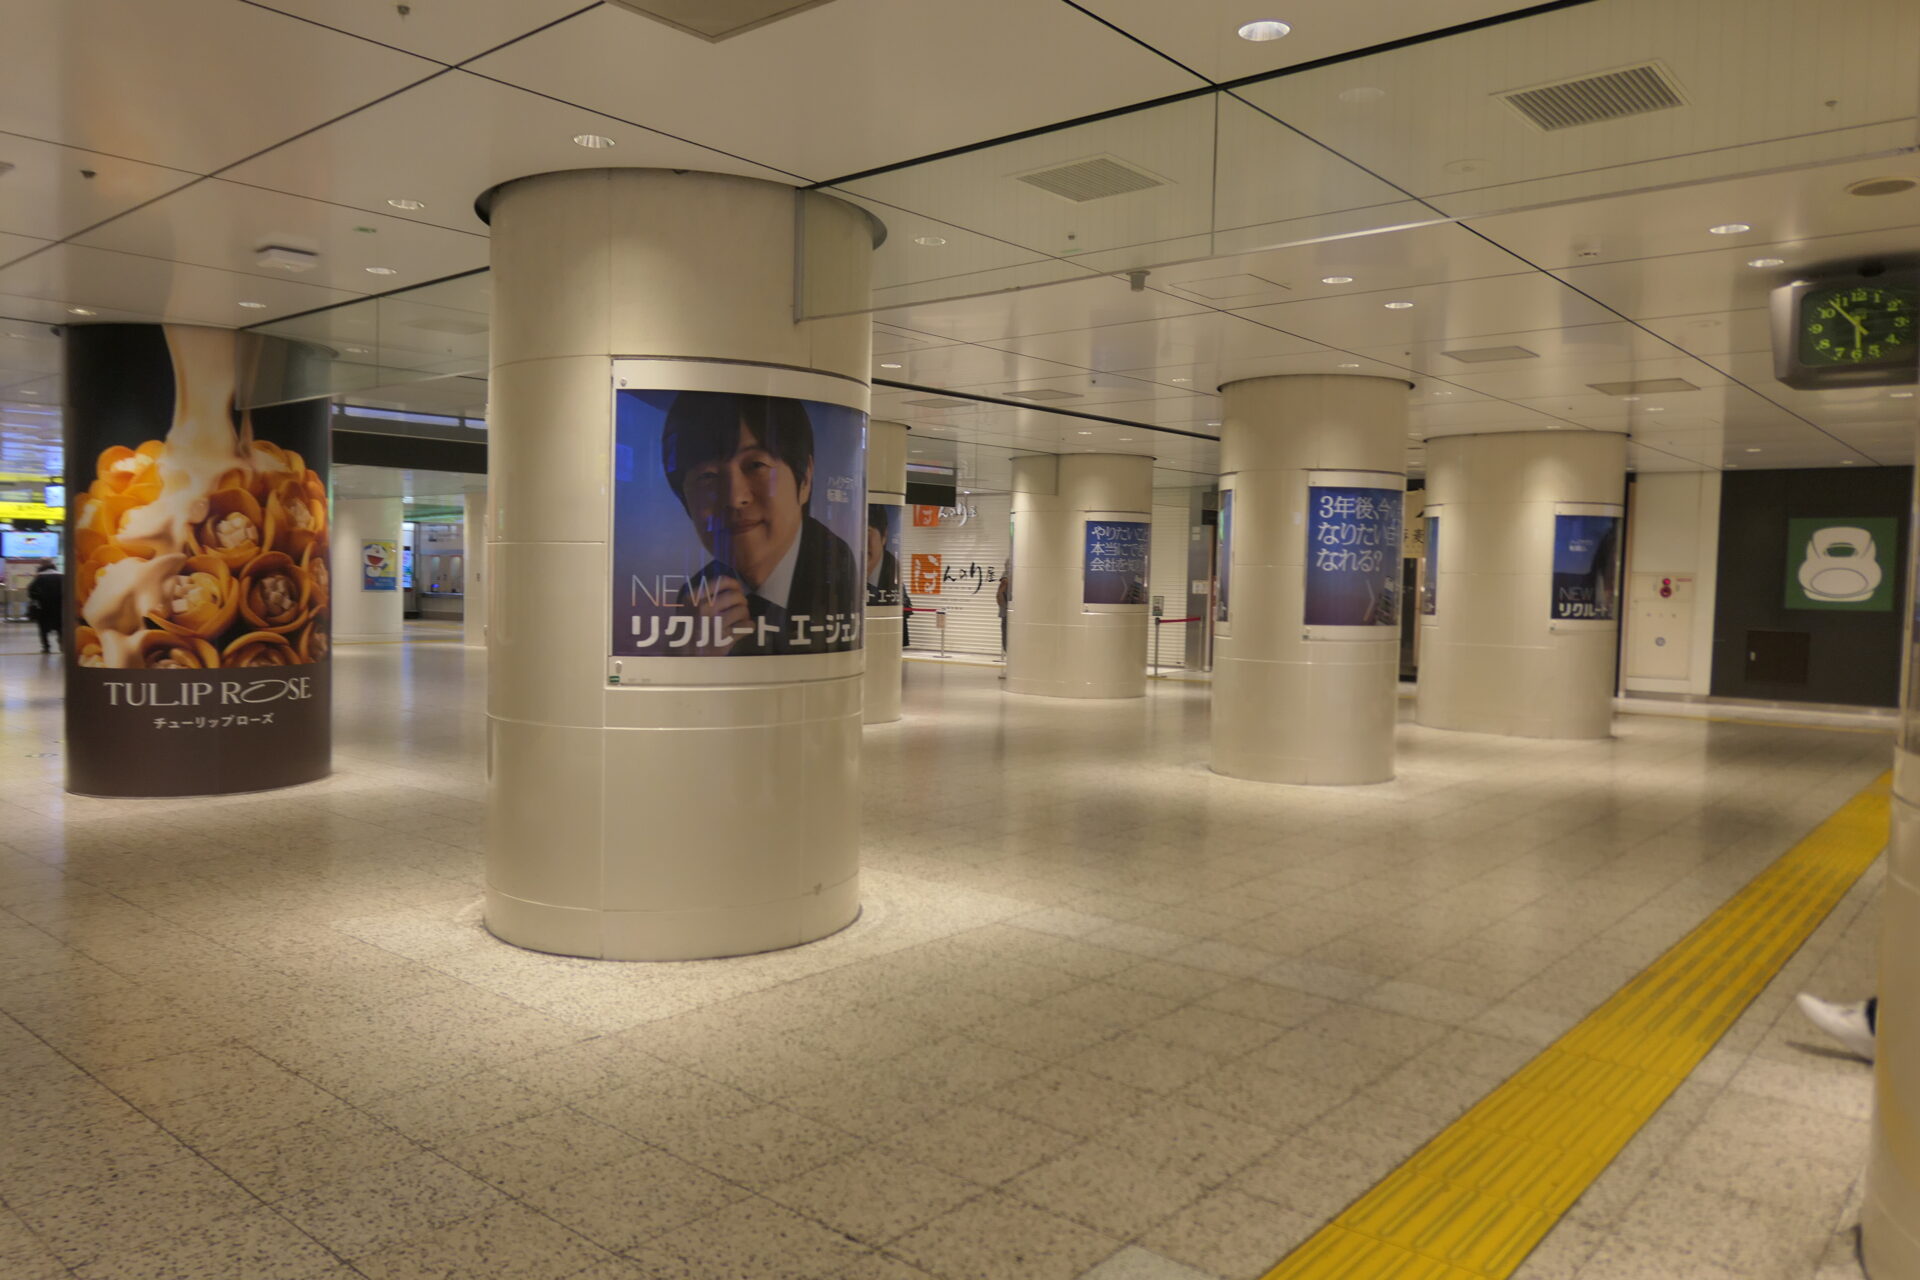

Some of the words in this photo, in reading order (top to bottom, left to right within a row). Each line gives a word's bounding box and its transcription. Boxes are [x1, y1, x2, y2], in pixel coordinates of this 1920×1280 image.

[1851, 290, 1868, 302] 12
[1887, 301, 1899, 312] 2
[1821, 308, 1837, 320] 10
[1894, 317, 1908, 328] 3
[1811, 323, 1824, 335] 9
[1819, 339, 1831, 350] 8
[1886, 334, 1898, 345] 4
[1834, 347, 1845, 358] 7
[1851, 350, 1863, 361] 6
[1868, 345, 1881, 358] 5
[631, 574, 721, 607] NEW
[631, 615, 780, 648] リクルート
[103, 682, 213, 706] TULIP
[220, 676, 313, 704] ROSE
[153, 712, 275, 730] チューリップローズ
